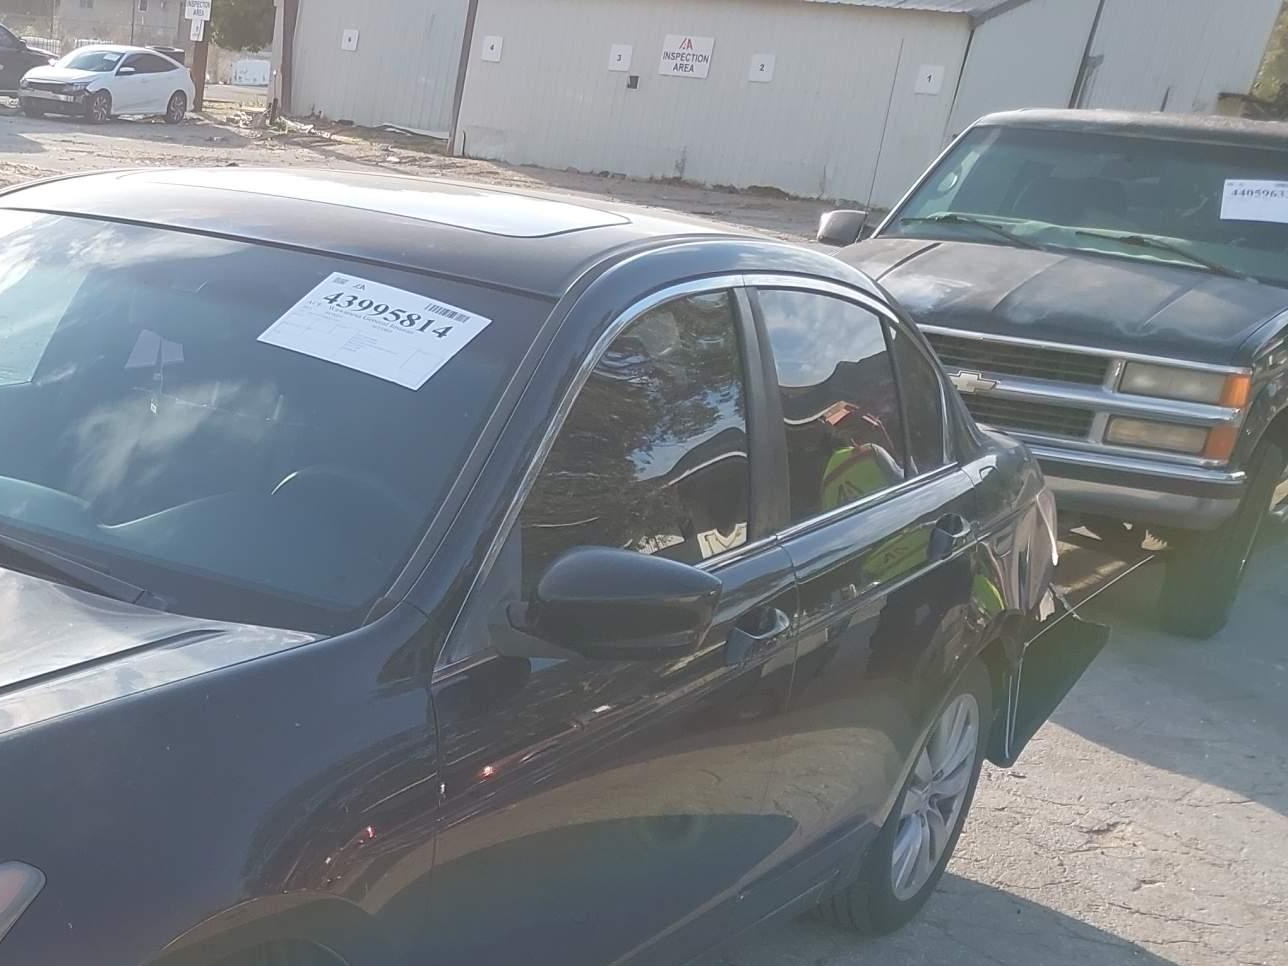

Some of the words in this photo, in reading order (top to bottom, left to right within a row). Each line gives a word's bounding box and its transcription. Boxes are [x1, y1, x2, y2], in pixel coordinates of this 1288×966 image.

[663, 51, 710, 64] INSPECTION
[673, 62, 694, 73] AREA
[322, 291, 454, 339] 43995814
